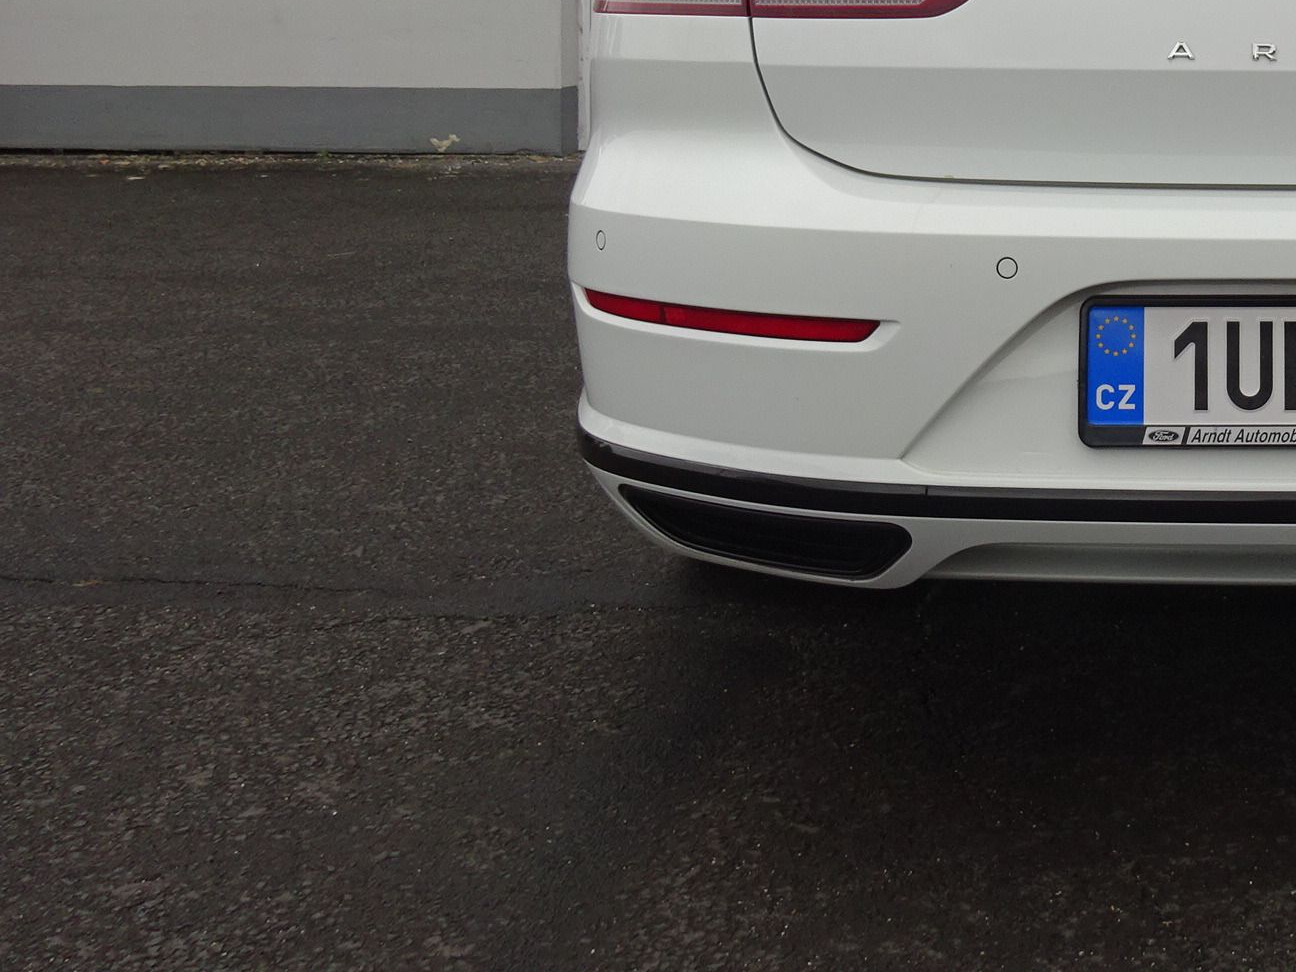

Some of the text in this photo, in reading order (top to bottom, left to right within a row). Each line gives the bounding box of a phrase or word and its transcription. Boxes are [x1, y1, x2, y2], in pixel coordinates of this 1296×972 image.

[1095, 384, 1136, 411] CZ
[1150, 430, 1178, 442] Ford
[1191, 428, 1232, 443] Arndt
